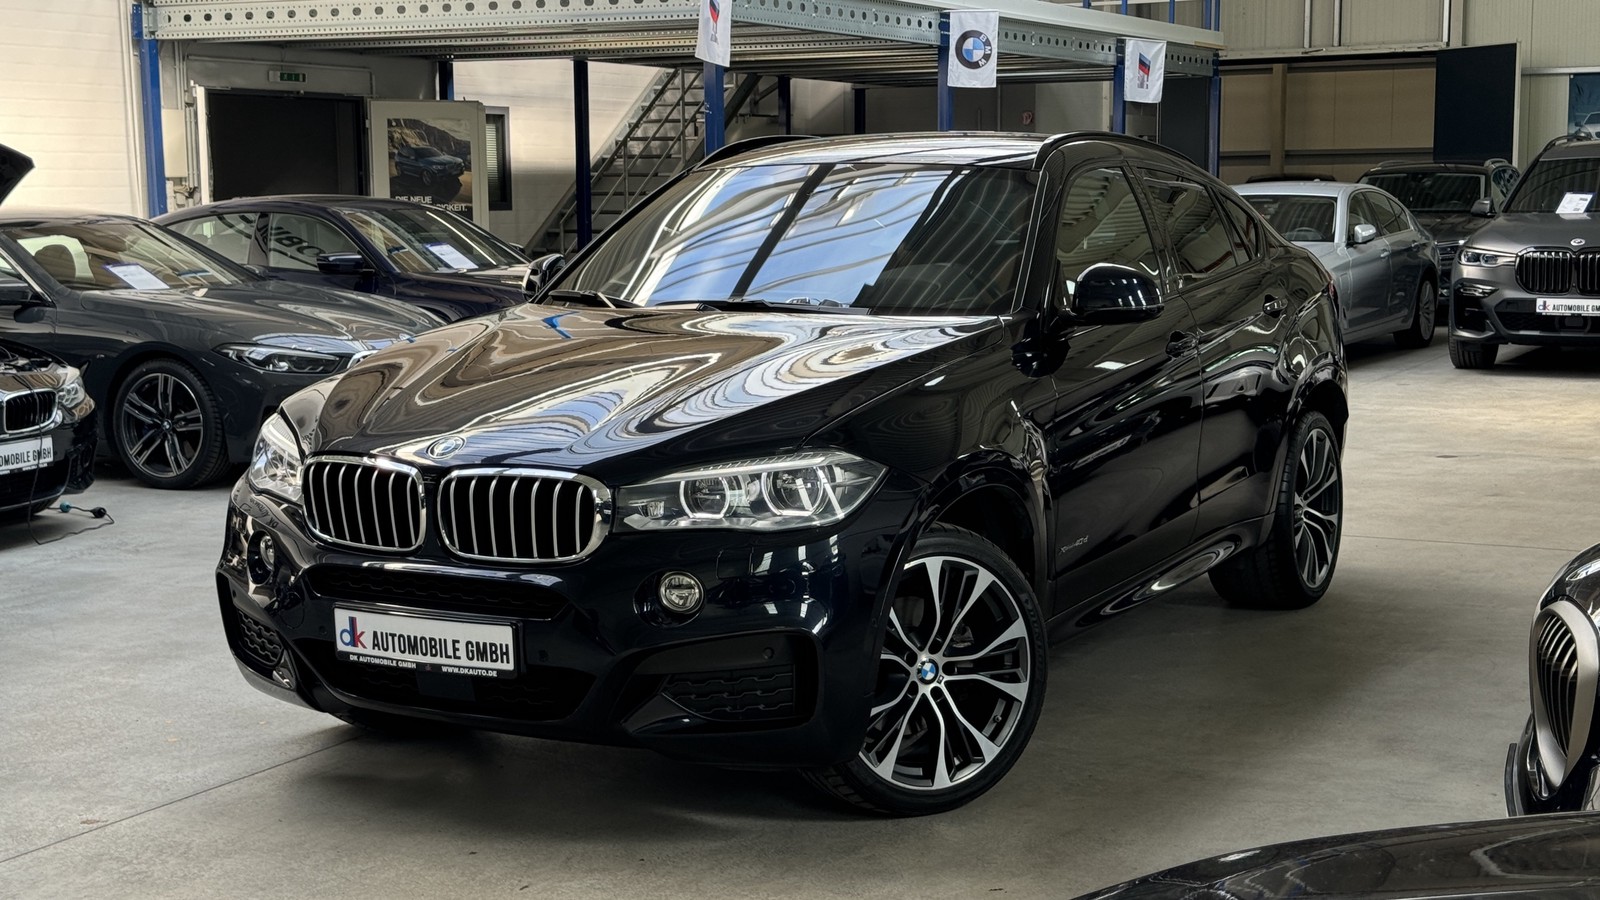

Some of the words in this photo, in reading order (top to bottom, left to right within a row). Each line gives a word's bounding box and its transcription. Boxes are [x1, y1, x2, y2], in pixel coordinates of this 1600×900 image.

[978, 33, 992, 67] BMW
[1552, 304, 1590, 312] AUTOMOBILE
[339, 616, 368, 649] dk
[372, 630, 461, 660] AUTOMOBILE
[465, 640, 510, 664] GMBH
[349, 654, 358, 662] DK
[359, 655, 397, 667] AUTOMOBILE
[397, 661, 417, 669] GMBH
[441, 665, 498, 677] WWW.DKAUTO.DE
